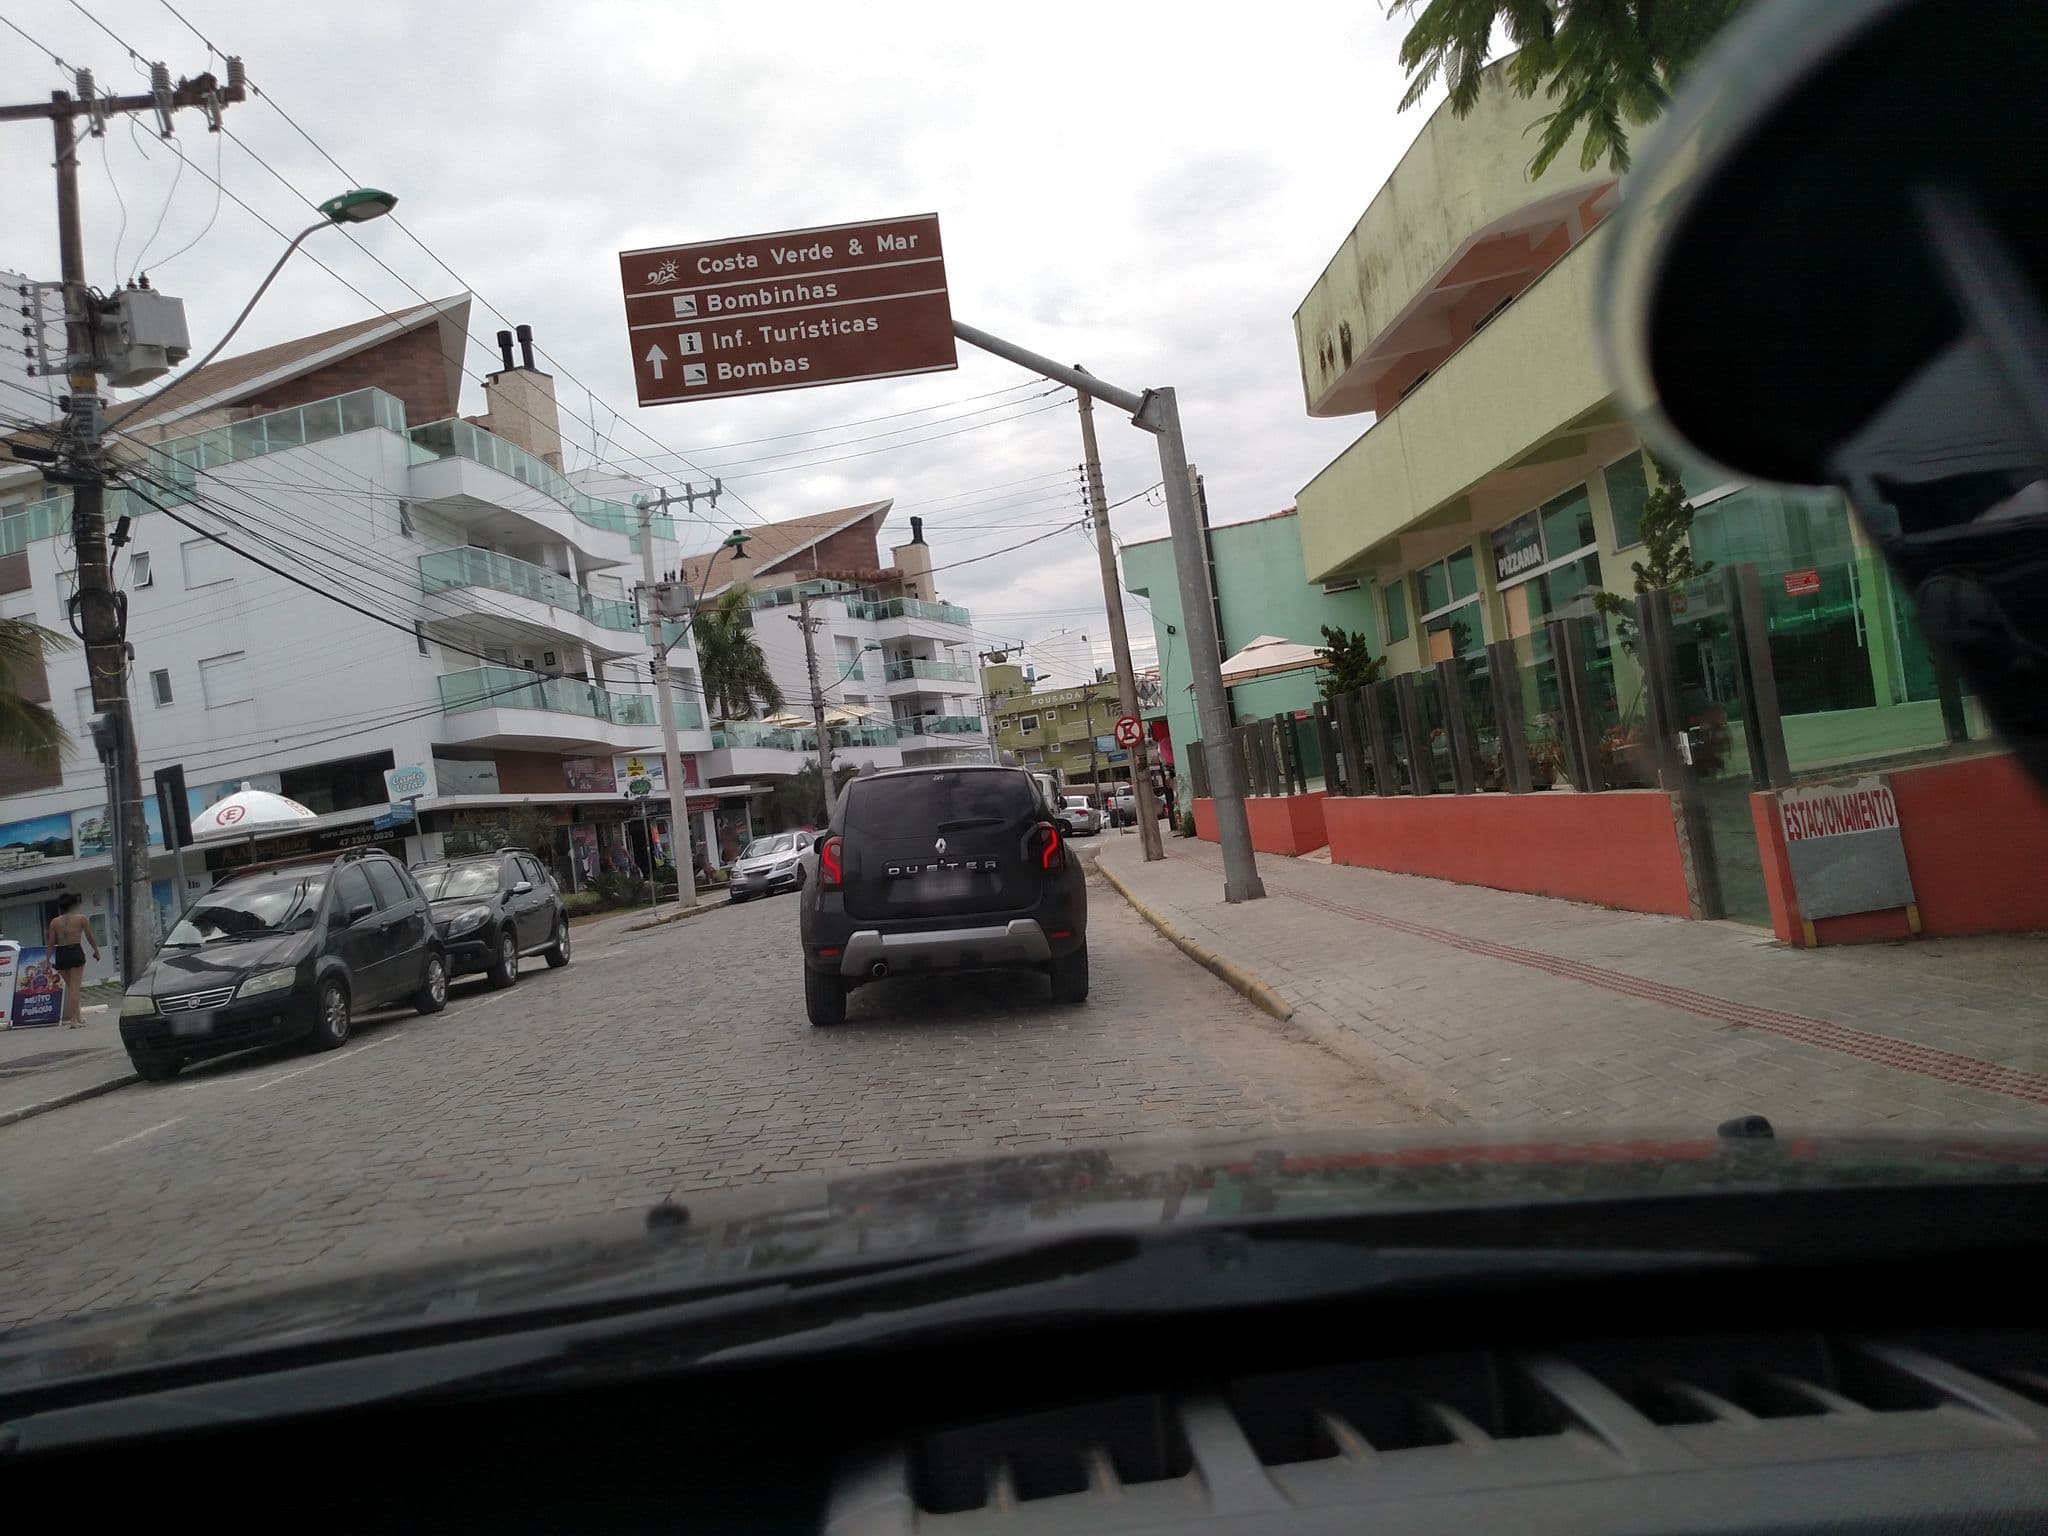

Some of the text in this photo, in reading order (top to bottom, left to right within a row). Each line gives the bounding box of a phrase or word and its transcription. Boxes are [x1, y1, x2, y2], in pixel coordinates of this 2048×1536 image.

[697, 233, 919, 275] Costa Verde & Mar
[707, 283, 838, 312] Bombinhas
[712, 317, 879, 350] Inf. Turísticas
[717, 356, 810, 380] Bombas
[1498, 543, 1541, 578] PIZZARIA
[1031, 692, 1081, 706] POUSADA
[1783, 789, 1895, 840] ESTACIONAMENTO
[888, 860, 996, 875] DUSTER
